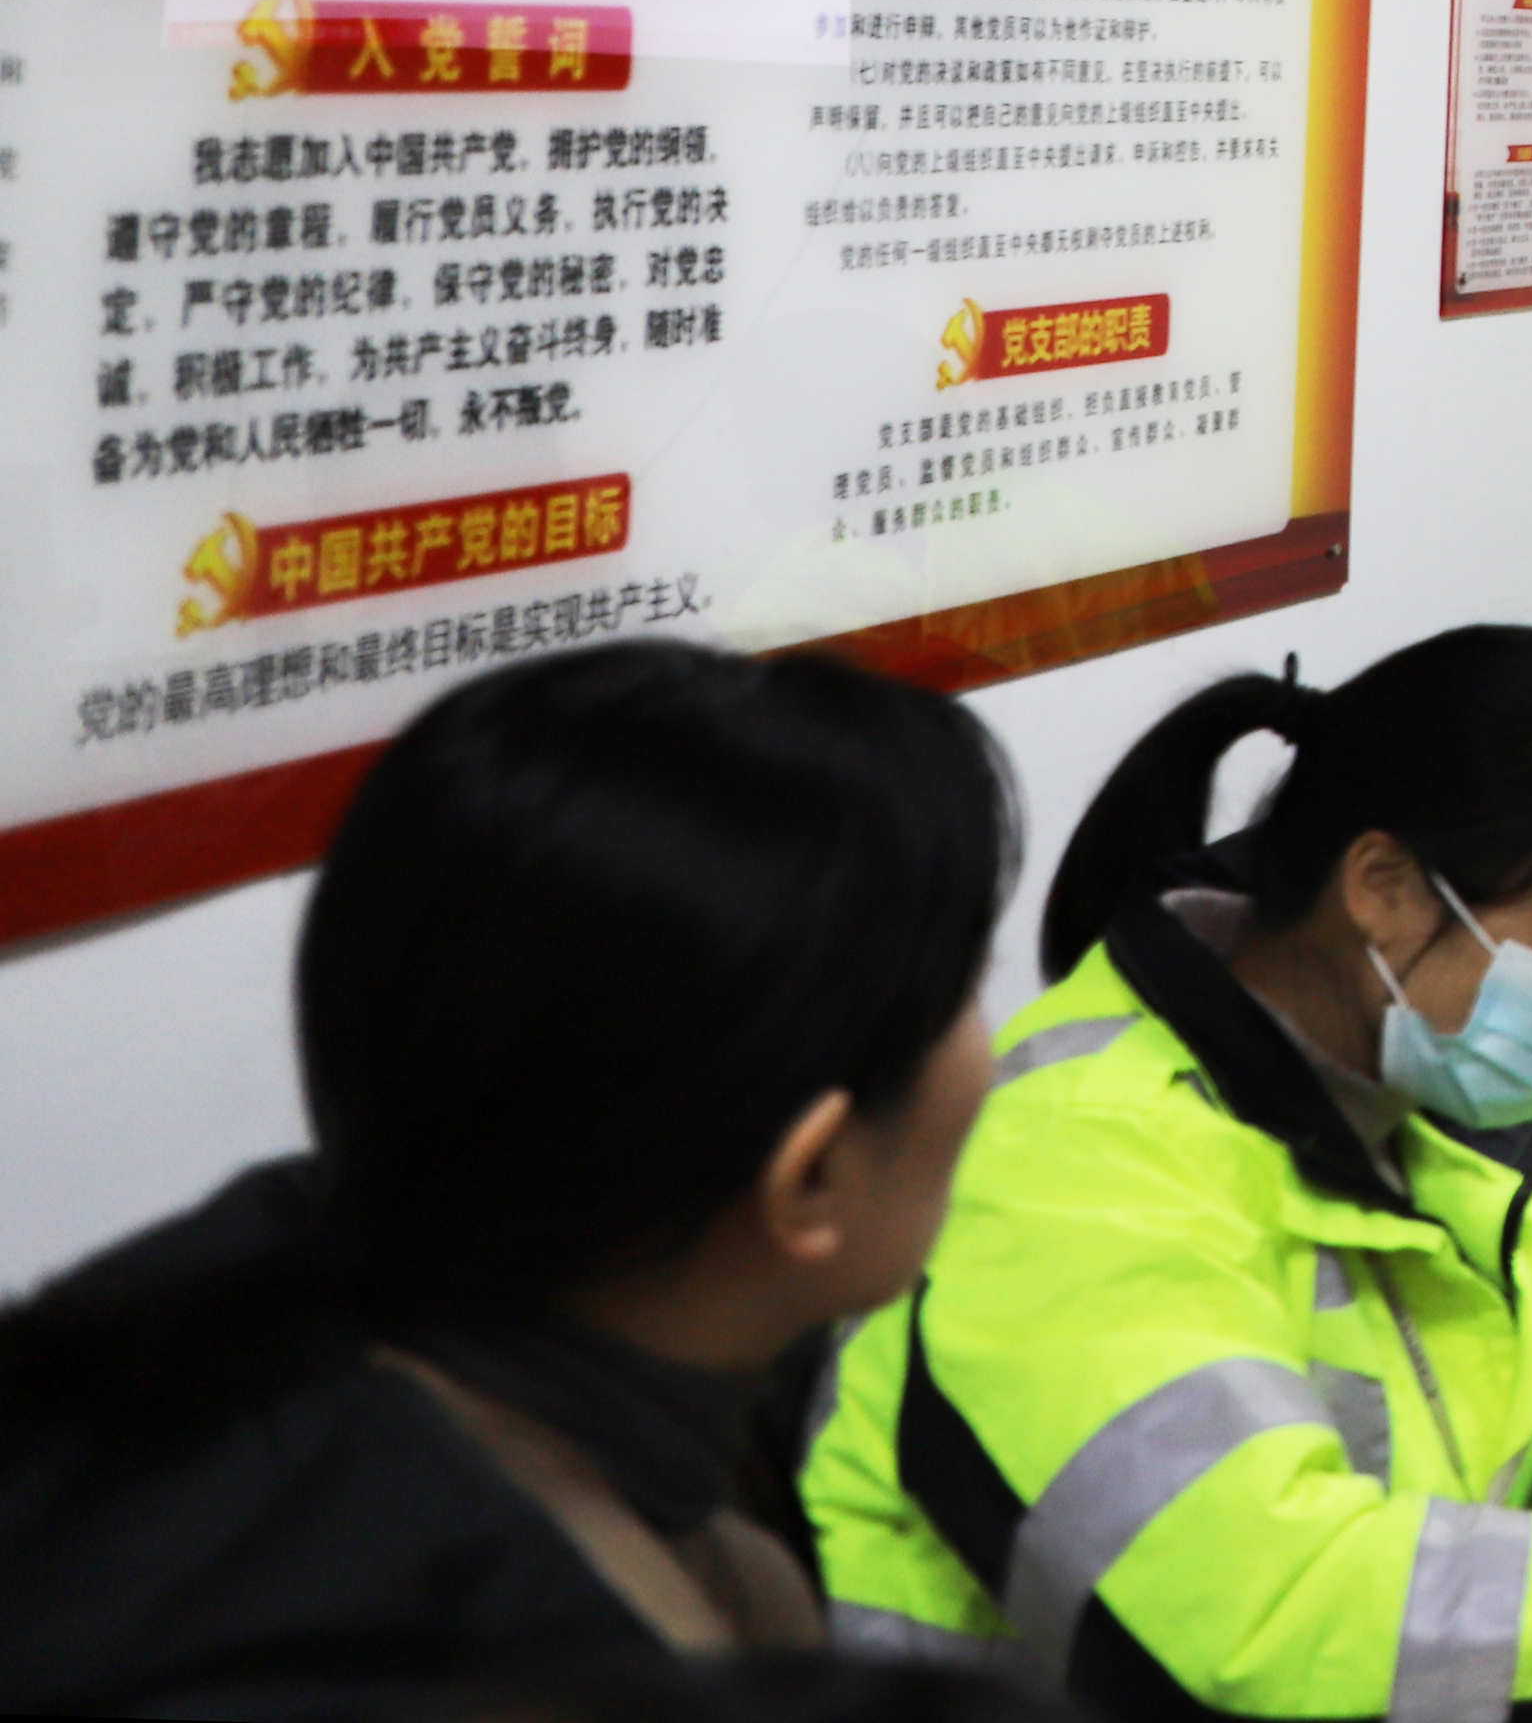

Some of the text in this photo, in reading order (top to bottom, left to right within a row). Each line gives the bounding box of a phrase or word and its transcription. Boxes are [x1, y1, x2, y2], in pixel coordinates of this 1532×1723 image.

[350, 15, 589, 81] 入党誓词
[1002, 304, 1152, 368] 党支部的职责
[270, 486, 622, 600] 中国共产党的目标
